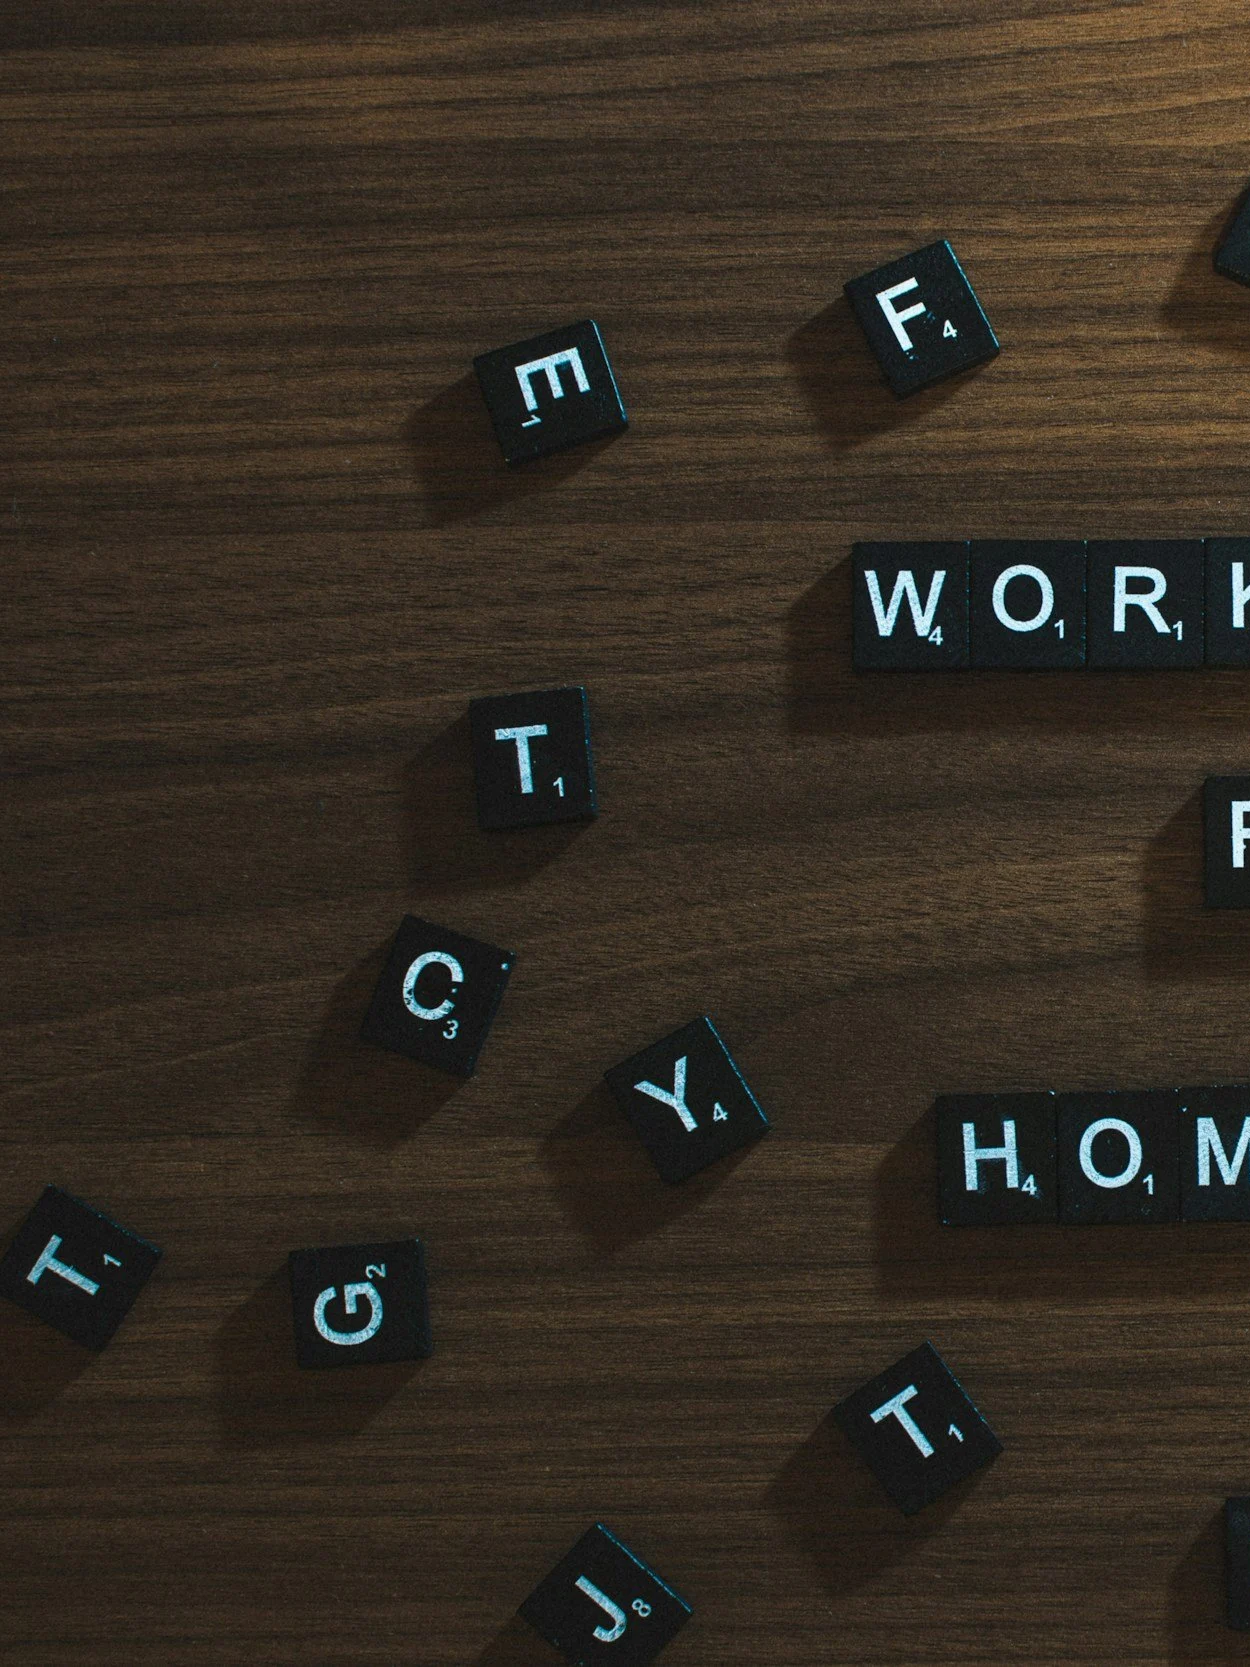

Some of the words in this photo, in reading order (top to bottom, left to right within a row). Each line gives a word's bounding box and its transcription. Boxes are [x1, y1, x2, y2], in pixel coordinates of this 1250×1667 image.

[875, 276, 927, 352] F
[942, 319, 958, 338] 4
[514, 346, 591, 412] E
[521, 414, 542, 428] 1
[928, 625, 944, 646] 4
[1054, 619, 1065, 639] 1
[1172, 620, 1183, 641] 1
[494, 724, 548, 794] T
[552, 776, 564, 797] 1
[402, 951, 464, 1021] C
[442, 1019, 459, 1040] 3
[633, 1055, 698, 1132] Y
[712, 1102, 728, 1122] 4
[1021, 1174, 1038, 1196] 4
[1142, 1173, 1154, 1195] 1
[26, 1234, 100, 1296] T
[103, 1253, 122, 1267] 1
[313, 1281, 383, 1346] G
[365, 1263, 386, 1279] 2
[869, 1384, 935, 1458] T
[948, 1423, 964, 1442] 1
[574, 1575, 627, 1643] J
[631, 1598, 652, 1618] 8
